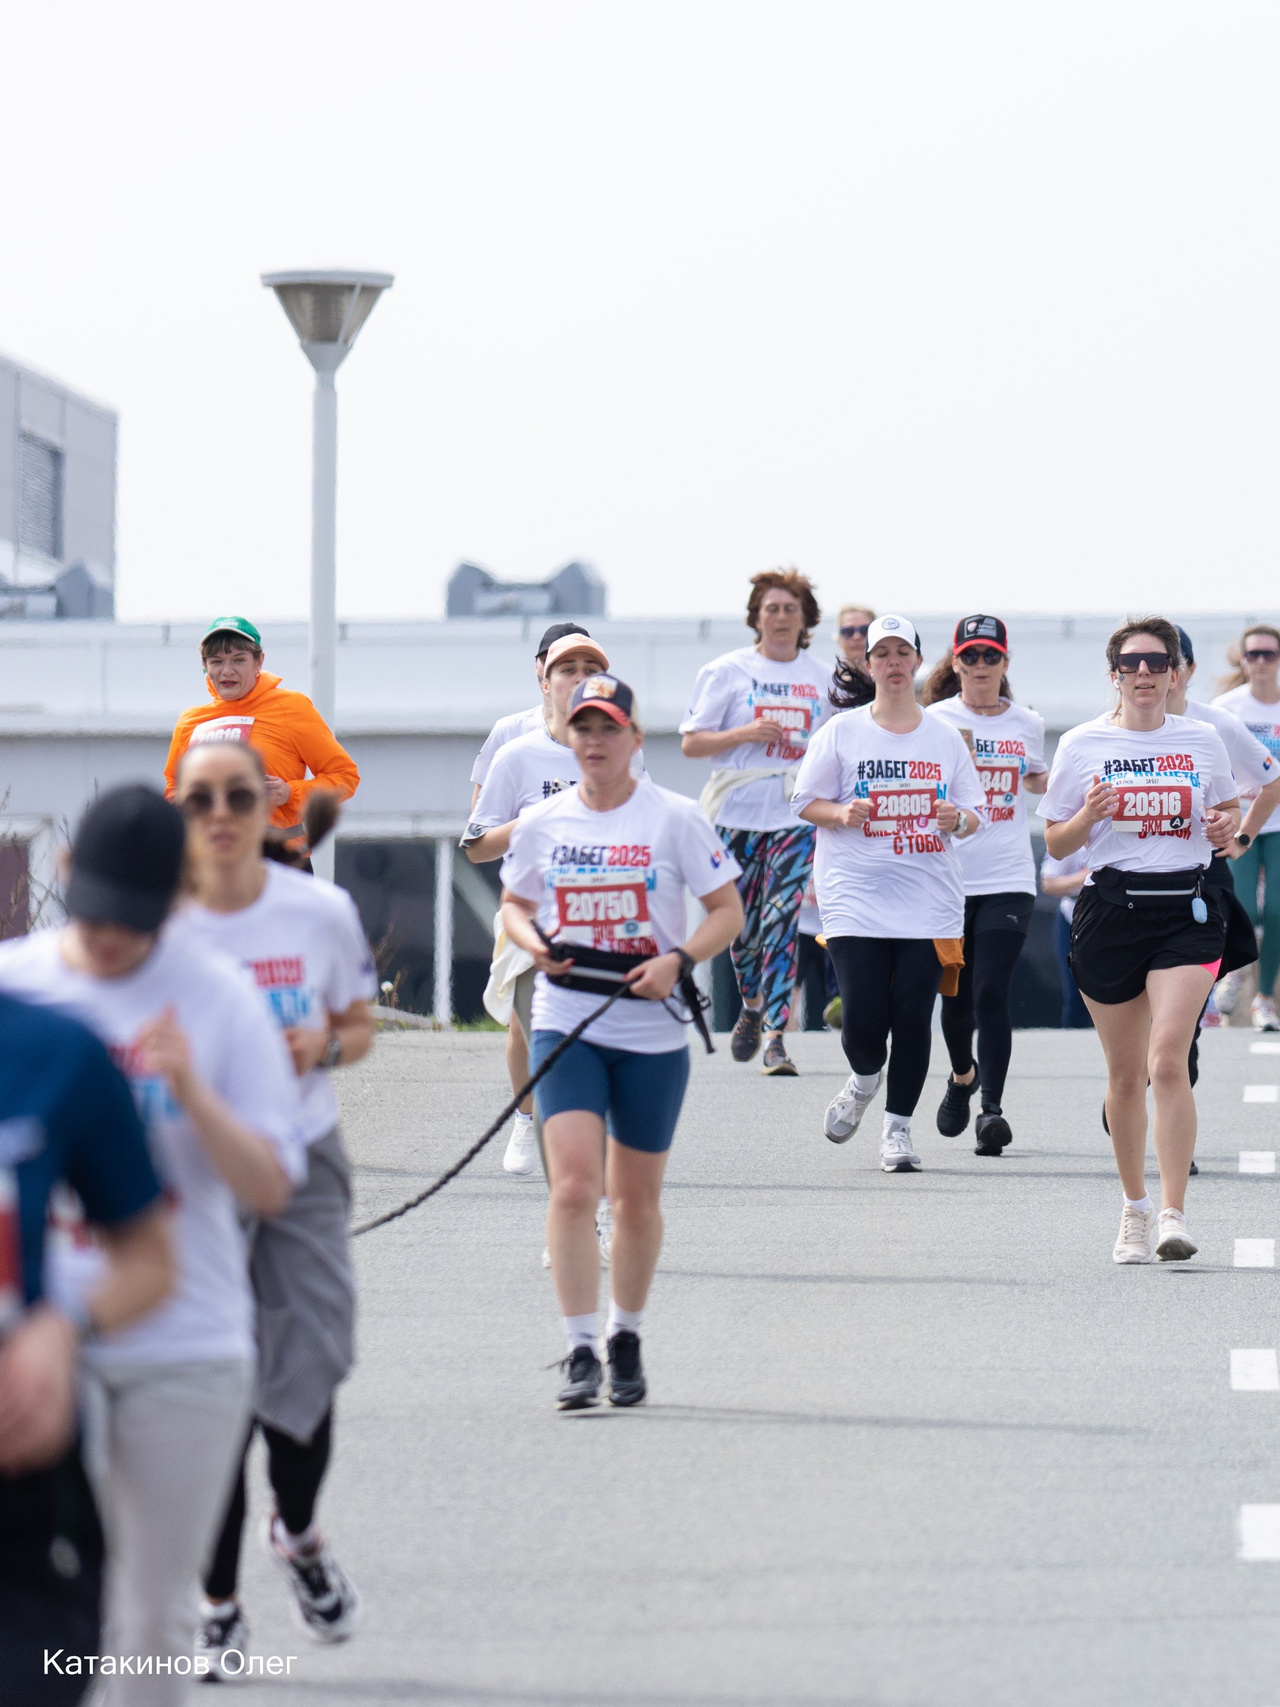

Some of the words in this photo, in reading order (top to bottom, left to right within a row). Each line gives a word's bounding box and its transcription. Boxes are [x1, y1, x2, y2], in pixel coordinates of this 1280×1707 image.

[976, 738, 1026, 758] БЕГ2025
[857, 759, 942, 781] #ЗАБЕГ2025
[1104, 753, 1195, 776] #ЗАБЕГ2025
[980, 770, 1013, 792] 840
[877, 793, 931, 818] 20805
[1123, 791, 1182, 817] 20316
[1141, 820, 1162, 834] 5KM
[908, 833, 946, 854] ТОБО
[564, 889, 639, 922] 20750
